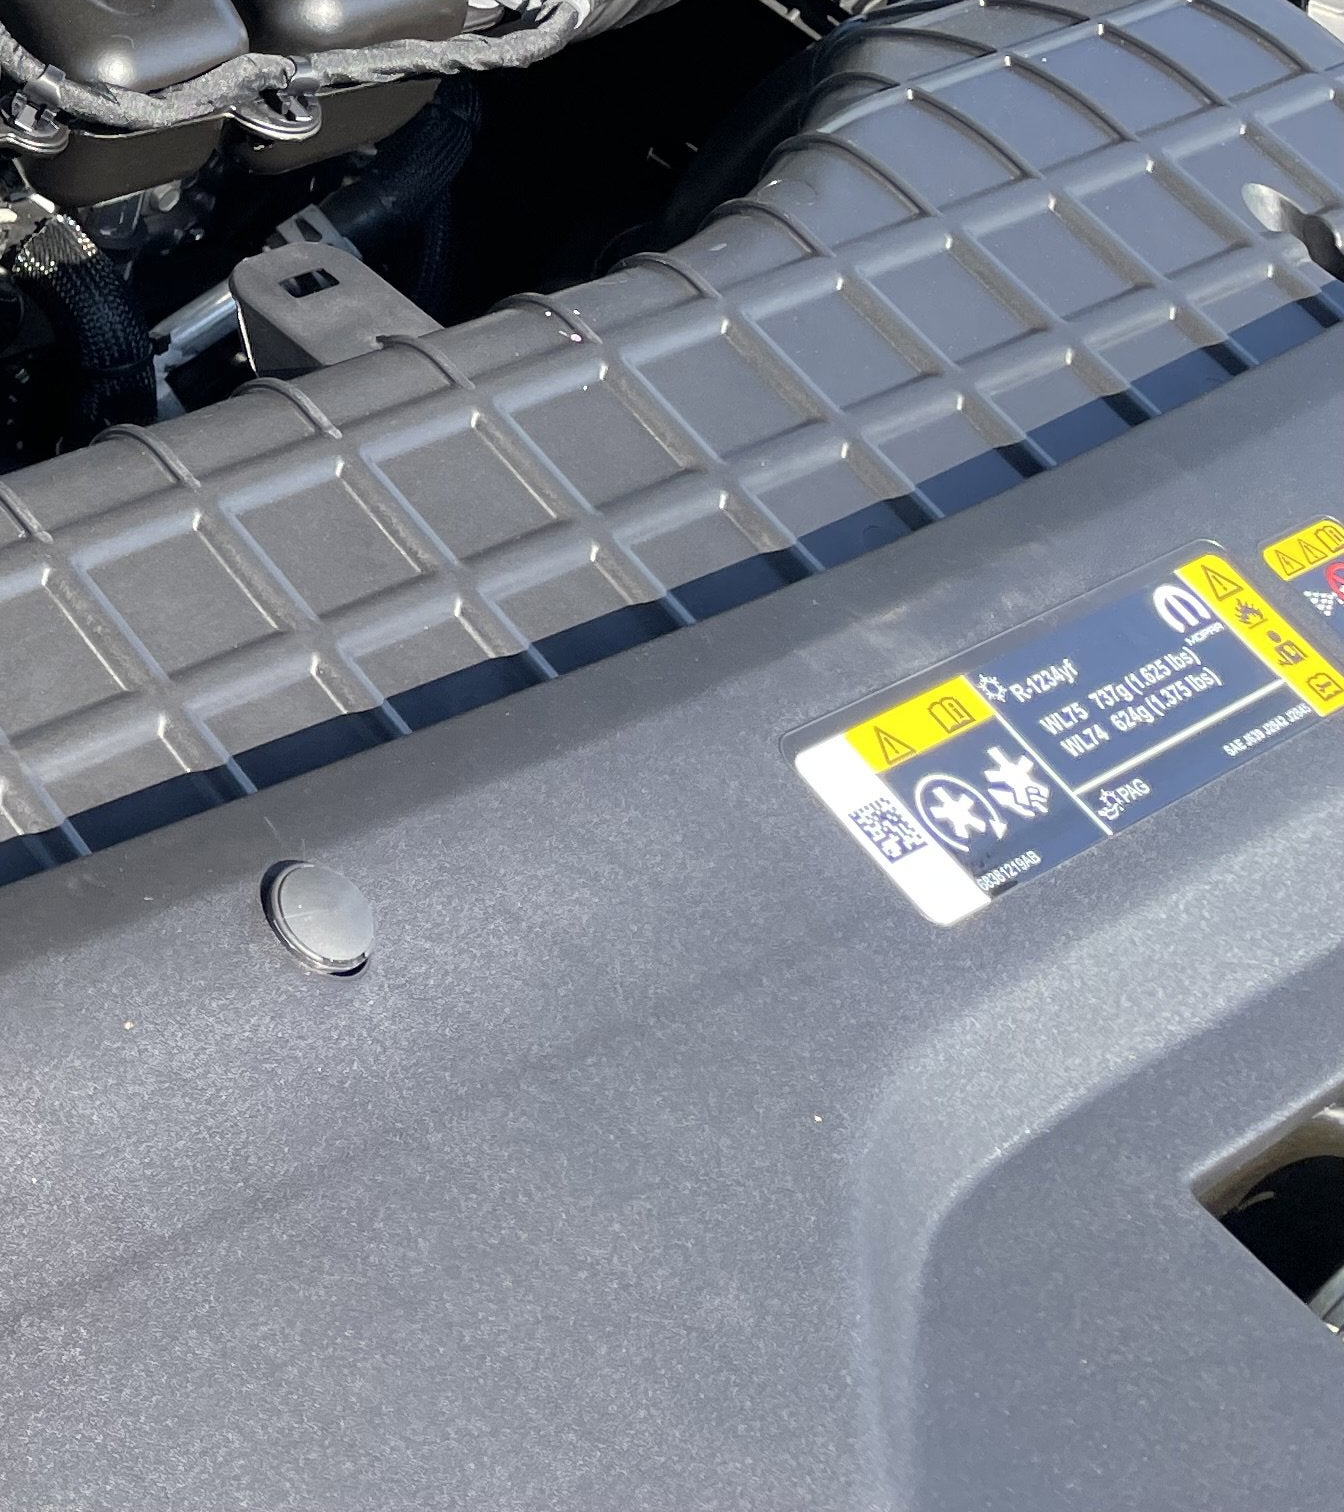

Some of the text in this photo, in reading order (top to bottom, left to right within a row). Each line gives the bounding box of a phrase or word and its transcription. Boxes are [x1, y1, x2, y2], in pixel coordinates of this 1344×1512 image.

[1009, 658, 1079, 703] R-1234yf
[1038, 645, 1202, 736] WL75 737g (1.625 lbs)
[1059, 666, 1226, 758] WL74 624g (1.375 lbs)
[1115, 778, 1151, 805] PAG
